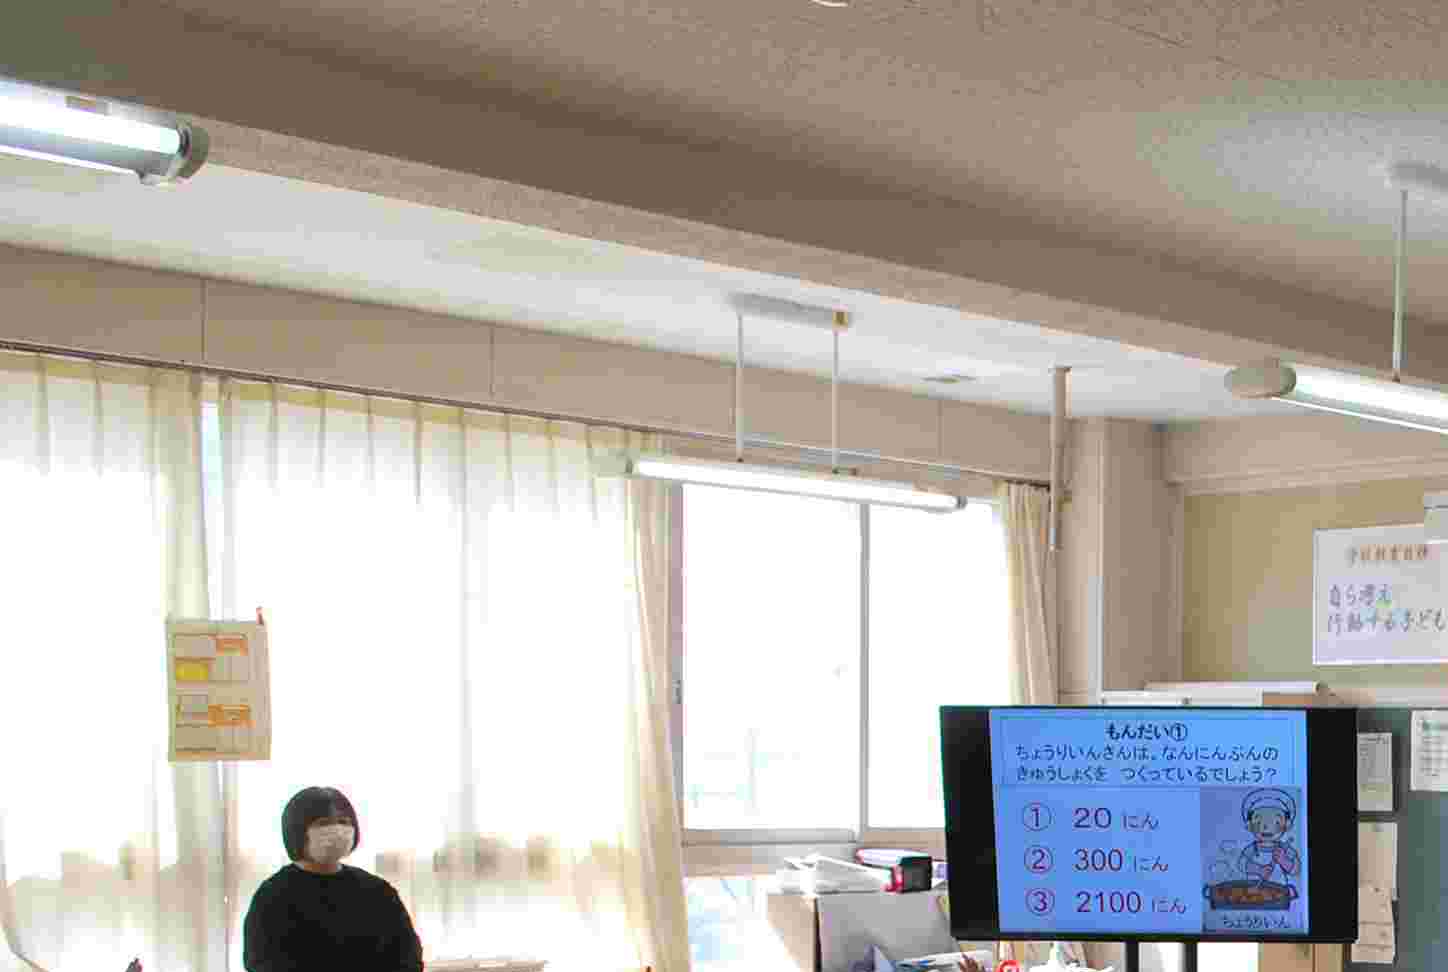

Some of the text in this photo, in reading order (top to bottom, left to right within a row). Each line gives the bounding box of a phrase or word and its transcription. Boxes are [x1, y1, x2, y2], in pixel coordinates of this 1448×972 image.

[1328, 583, 1392, 607] 自ら考え
[1327, 608, 1446, 633] 行動する子ども
[1104, 721, 1189, 741] もんだい①
[1015, 765, 1107, 782] きゅうしょくを
[1022, 801, 1160, 832] ① 20 にん
[1023, 844, 1169, 875] ② 300 にん
[1025, 885, 1187, 917] ③ 2100 にん
